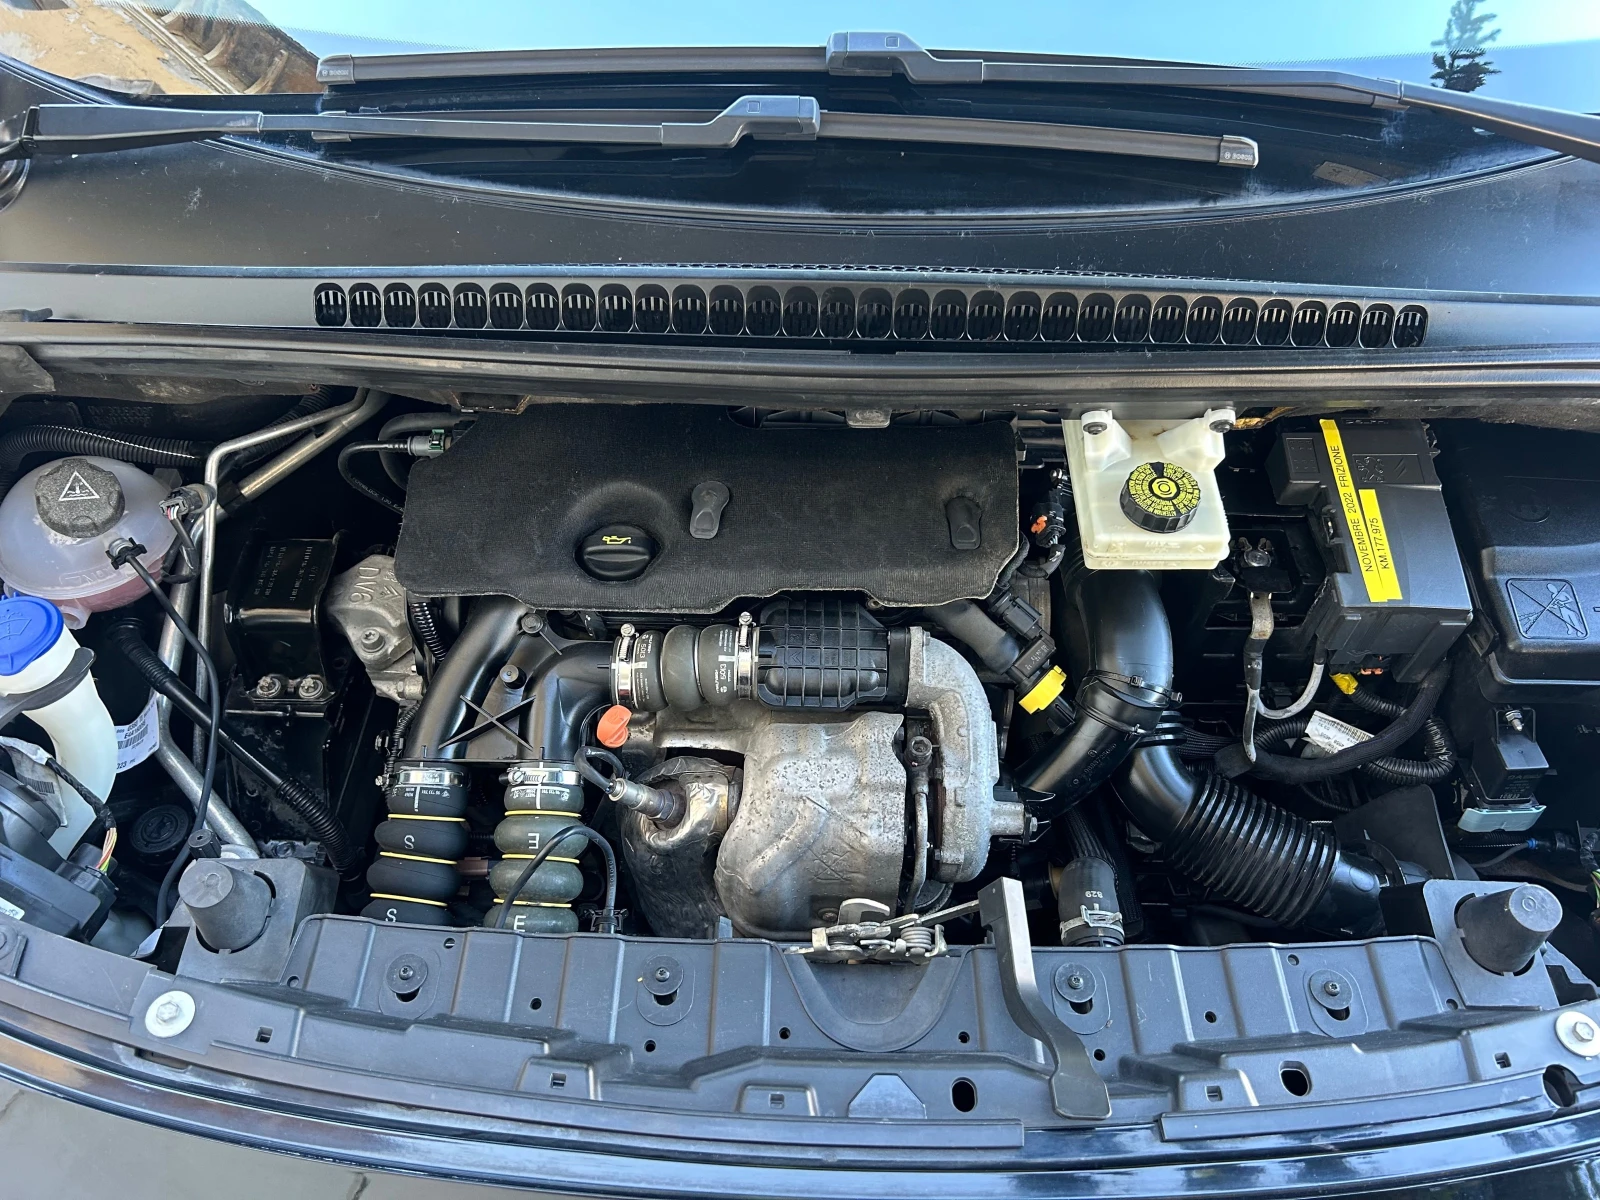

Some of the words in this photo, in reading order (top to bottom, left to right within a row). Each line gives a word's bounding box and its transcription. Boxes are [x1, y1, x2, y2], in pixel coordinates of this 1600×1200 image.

[1232, 153, 1253, 161] BOSCH
[1331, 445, 1350, 489] FRIZIONE
[1342, 492, 1357, 514] 2022
[1351, 518, 1373, 572] NOVEMBRE
[1370, 518, 1390, 570] KM.177.975
[349, 567, 381, 604] DV6
[404, 834, 415, 850] S
[528, 832, 539, 850] E
[385, 908, 397, 922] S
[513, 915, 527, 932] E
